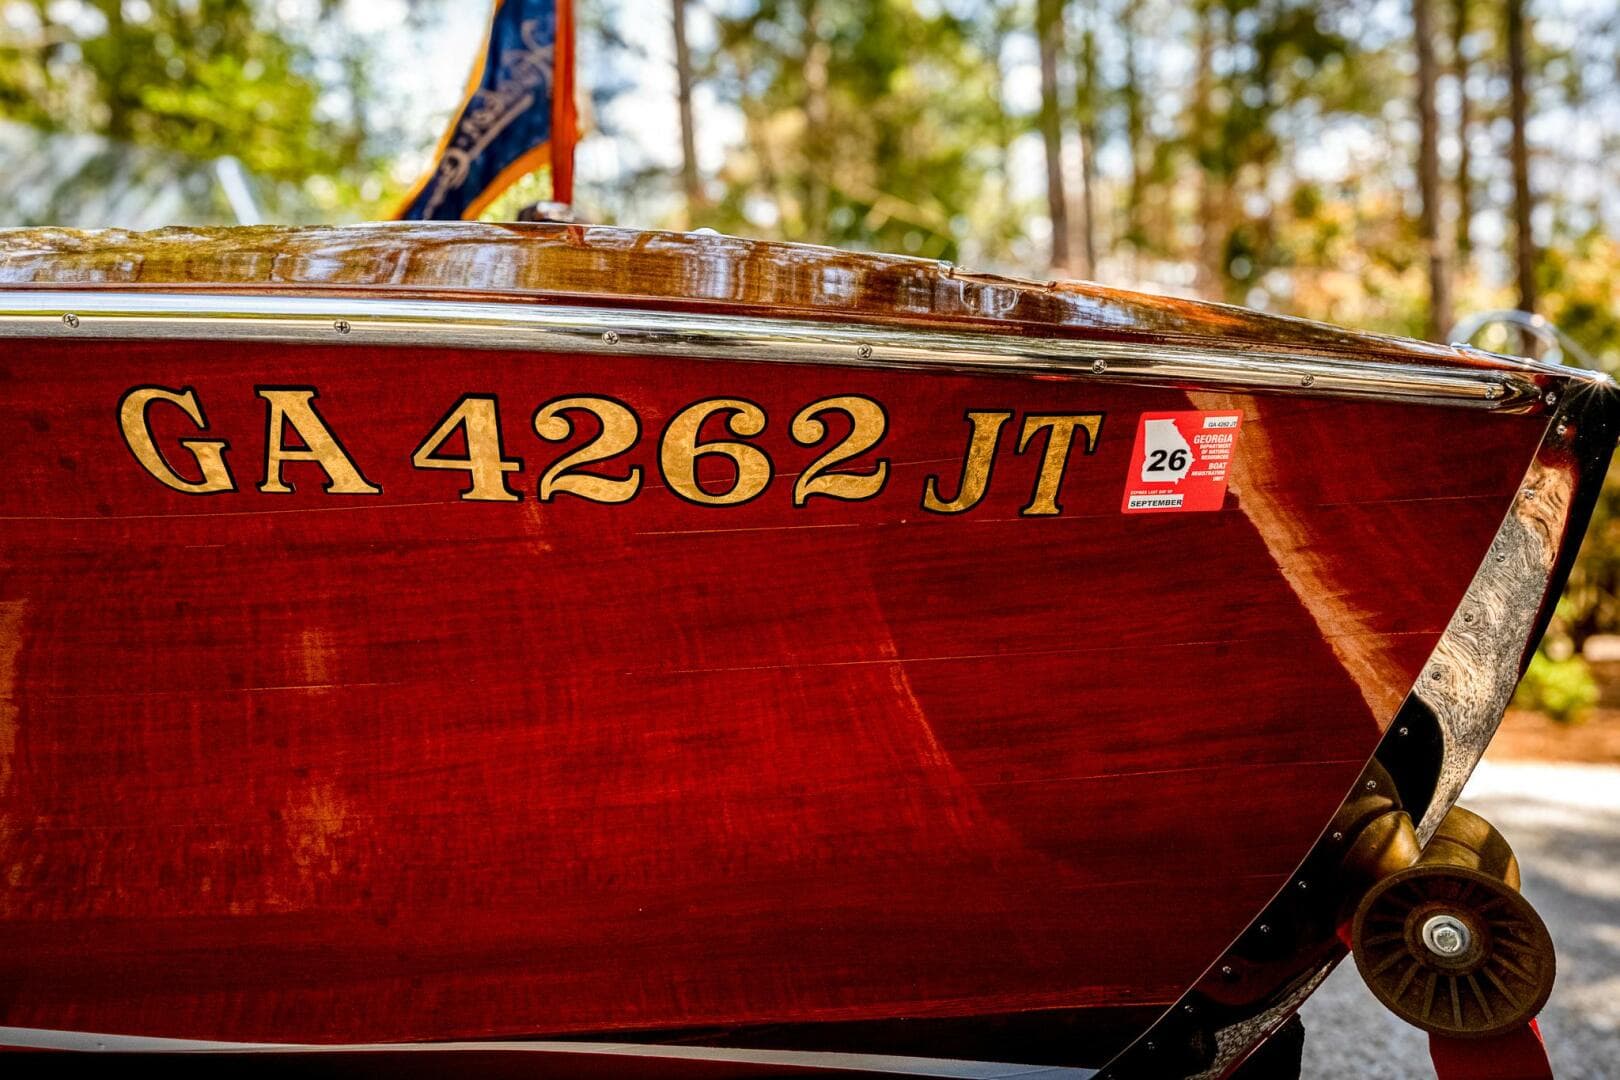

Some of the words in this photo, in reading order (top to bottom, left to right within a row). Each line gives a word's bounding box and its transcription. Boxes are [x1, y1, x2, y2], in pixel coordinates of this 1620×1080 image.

[1193, 434, 1233, 444] GEORGIA
[117, 385, 383, 495] GA
[411, 393, 890, 507] 4262
[921, 410, 1105, 516] JT
[1146, 449, 1188, 472] 26
[1208, 462, 1227, 470] BOAT
[1130, 499, 1182, 507] SEPTEMBER
